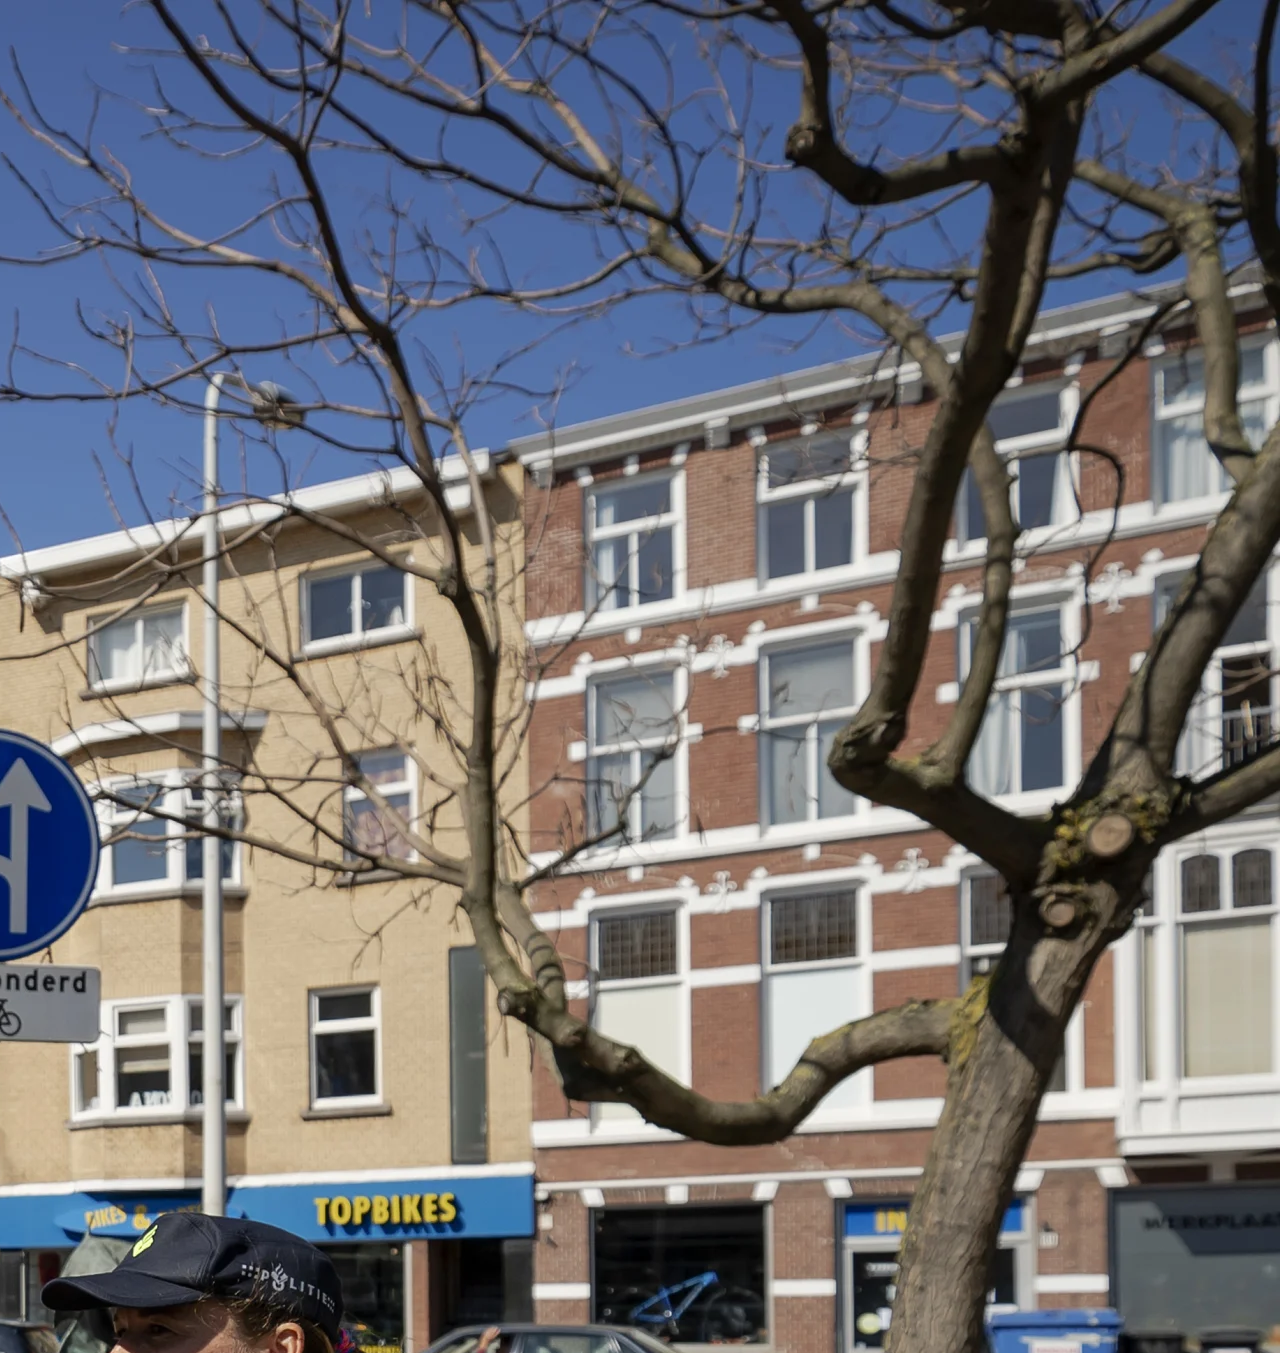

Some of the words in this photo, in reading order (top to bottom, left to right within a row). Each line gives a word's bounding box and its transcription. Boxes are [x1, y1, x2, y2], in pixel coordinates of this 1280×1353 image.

[84, 1204, 127, 1230] BIKES
[132, 1205, 151, 1230] &
[314, 1191, 457, 1226] TOPBIKES
